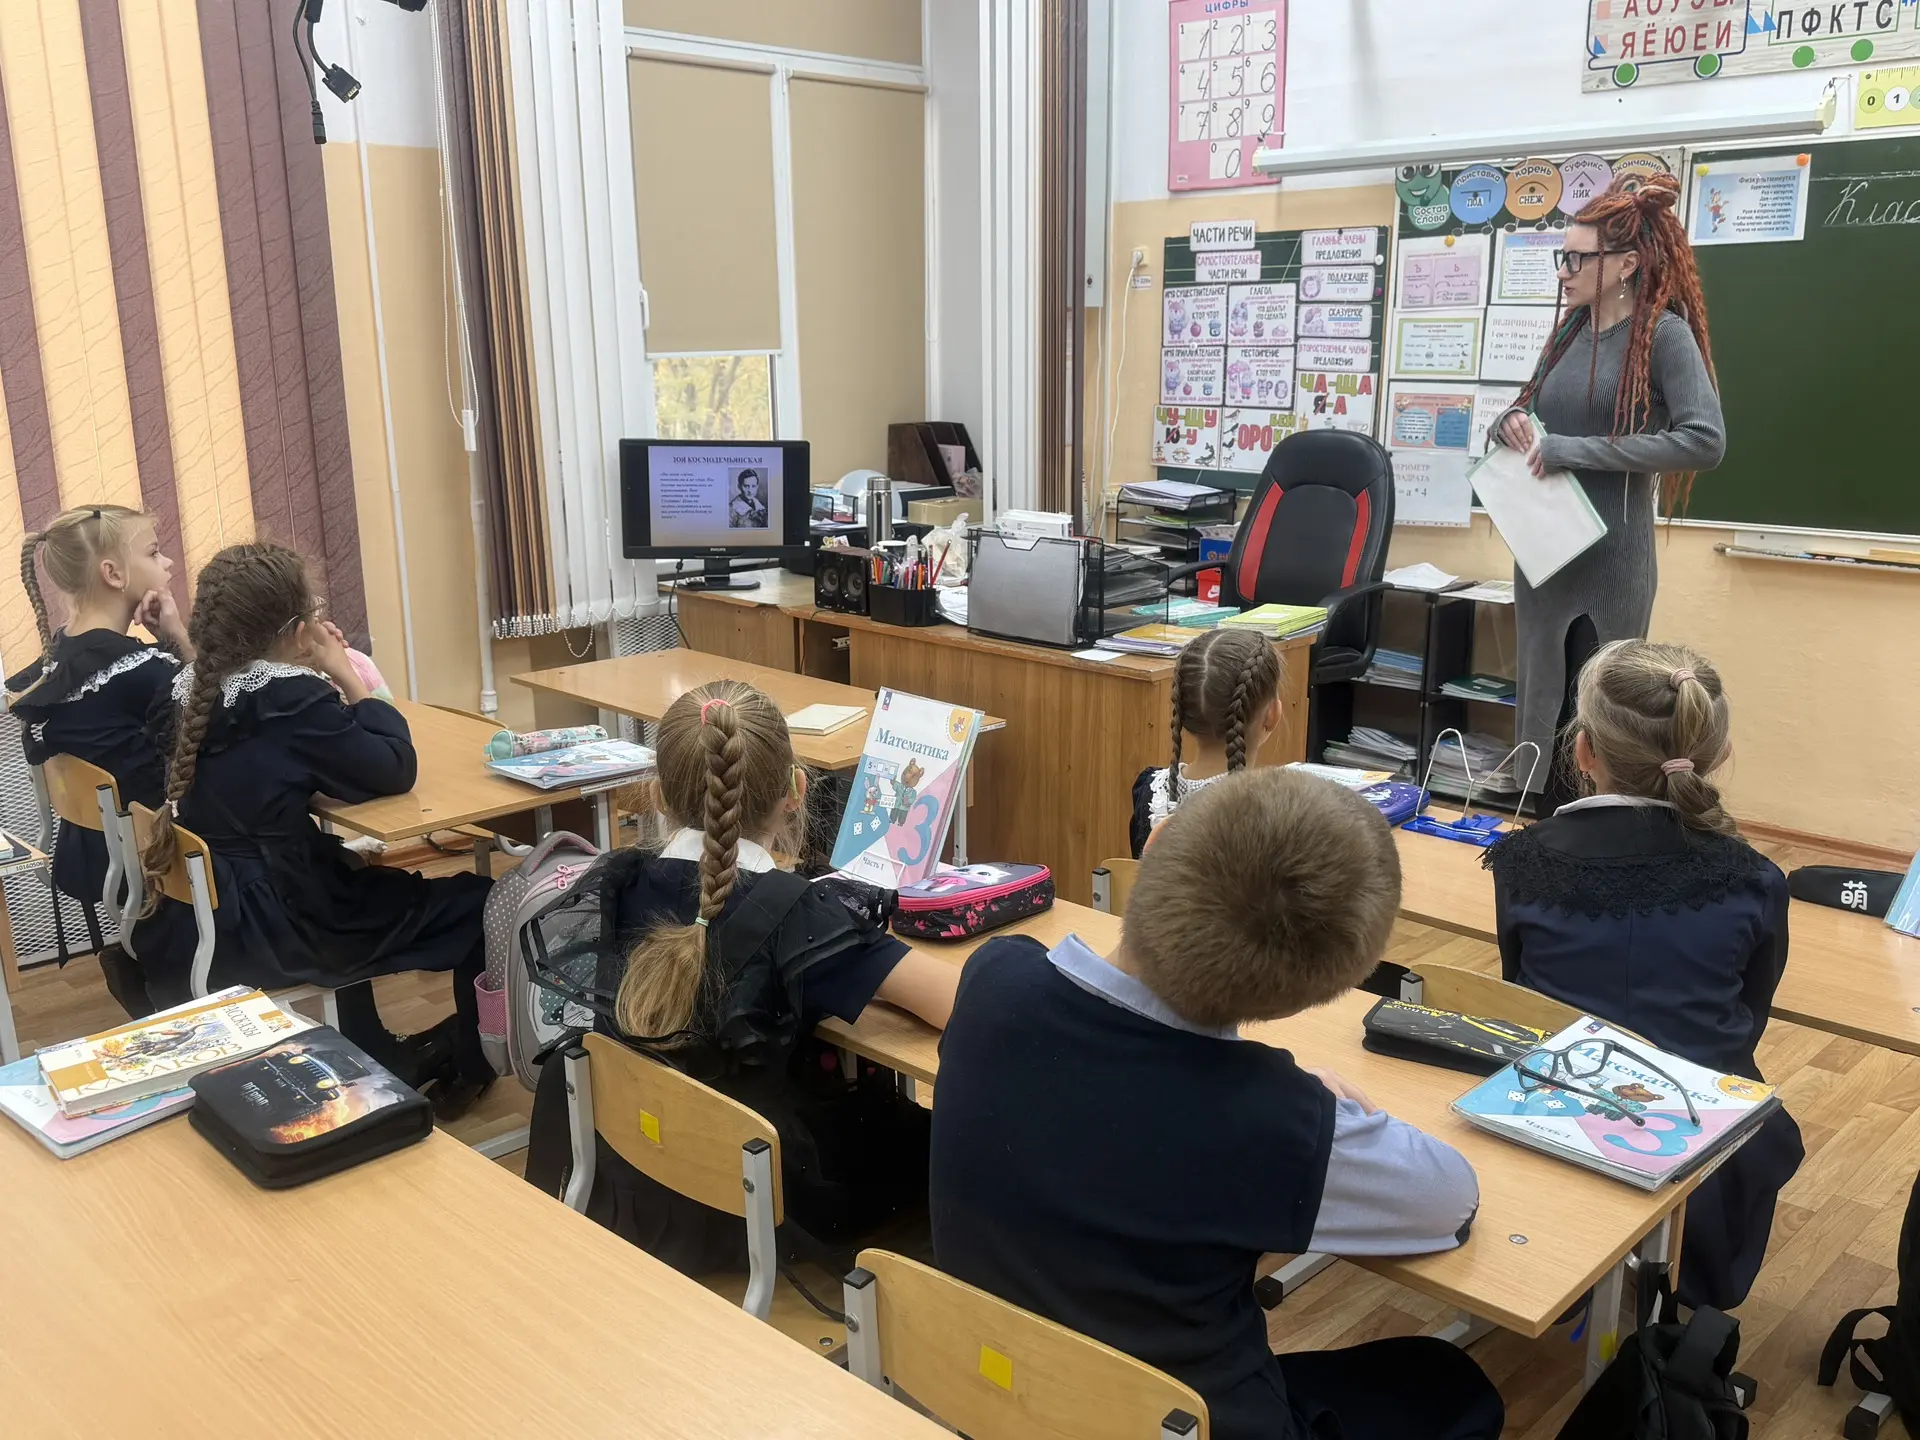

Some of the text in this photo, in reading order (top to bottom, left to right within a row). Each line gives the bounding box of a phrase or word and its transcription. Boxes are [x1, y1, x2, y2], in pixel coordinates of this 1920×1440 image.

[1205, 0, 1248, 13] ЦИФРЫ
[1213, 20, 1218, 30] 2
[1246, 15, 1251, 25] 3
[1229, 24, 1243, 56] 2
[1262, 19, 1276, 51] 3
[1199, 28, 1210, 59] 1
[1213, 61, 1218, 71] 5
[1246, 57, 1251, 67] 6
[1180, 65, 1185, 75] 4
[1228, 66, 1243, 97] 5
[1260, 62, 1276, 93] 6
[1197, 69, 1210, 100] 4
[1245, 99, 1250, 109] 9
[1867, 94, 1900, 106] 0 1
[1212, 102, 1217, 112] 8
[1197, 111, 1209, 140] 7
[1227, 107, 1242, 138] 8
[1260, 104, 1275, 135] 9
[1211, 143, 1216, 153] 0
[1225, 148, 1241, 178] 0
[1564, 159, 1604, 172] суффикс
[1612, 159, 1663, 173] окончание
[1456, 170, 1501, 185] приставка
[1515, 166, 1552, 178] корень
[1519, 195, 1544, 205] СНЕЖ
[1572, 189, 1591, 199] НИК
[1467, 199, 1483, 207] ПОД
[1414, 205, 1448, 215] Состав
[1416, 215, 1445, 224] слова
[1193, 226, 1253, 243] ЧАСТИ РЕЧИ
[1312, 234, 1366, 246] ГЛАВНЫЕ ЧЛЕНЫ
[1197, 254, 1260, 266] САМОСТОЯТЕЛЬНЫЕ
[1315, 249, 1361, 260] ПРЕДЛОЖЕНИЯ
[1208, 269, 1247, 279] ЧАСТИ РЕЧИ
[1327, 273, 1368, 282] ПОДЛЕЖАЩЕЕ
[1177, 287, 1225, 298] СУЩЕСТВИТЕЛЬНОЕ
[1250, 287, 1272, 295] ГЛАГОЛ
[1328, 308, 1363, 317] СКАЗУЕМОЕ
[1241, 349, 1280, 357] МЕСТОИМЕНИЕ
[1313, 356, 1353, 366] ПРЕДЛОЖЕНИЯ
[1300, 373, 1372, 397] ЧА-ЩА
[1156, 407, 1217, 430] ЧУ-ЩУ
[1238, 424, 1273, 452] ОРО
[875, 727, 950, 761] Математика
[897, 794, 940, 867] 3
[863, 856, 880, 869] Часть
[1841, 881, 1868, 911] 萌
[223, 1003, 261, 1037] РАССКАЗЫ
[69, 1043, 243, 1096] КАЗАКОВ
[1526, 1120, 1560, 1135] Часть
[1603, 1112, 1703, 1156] 3
